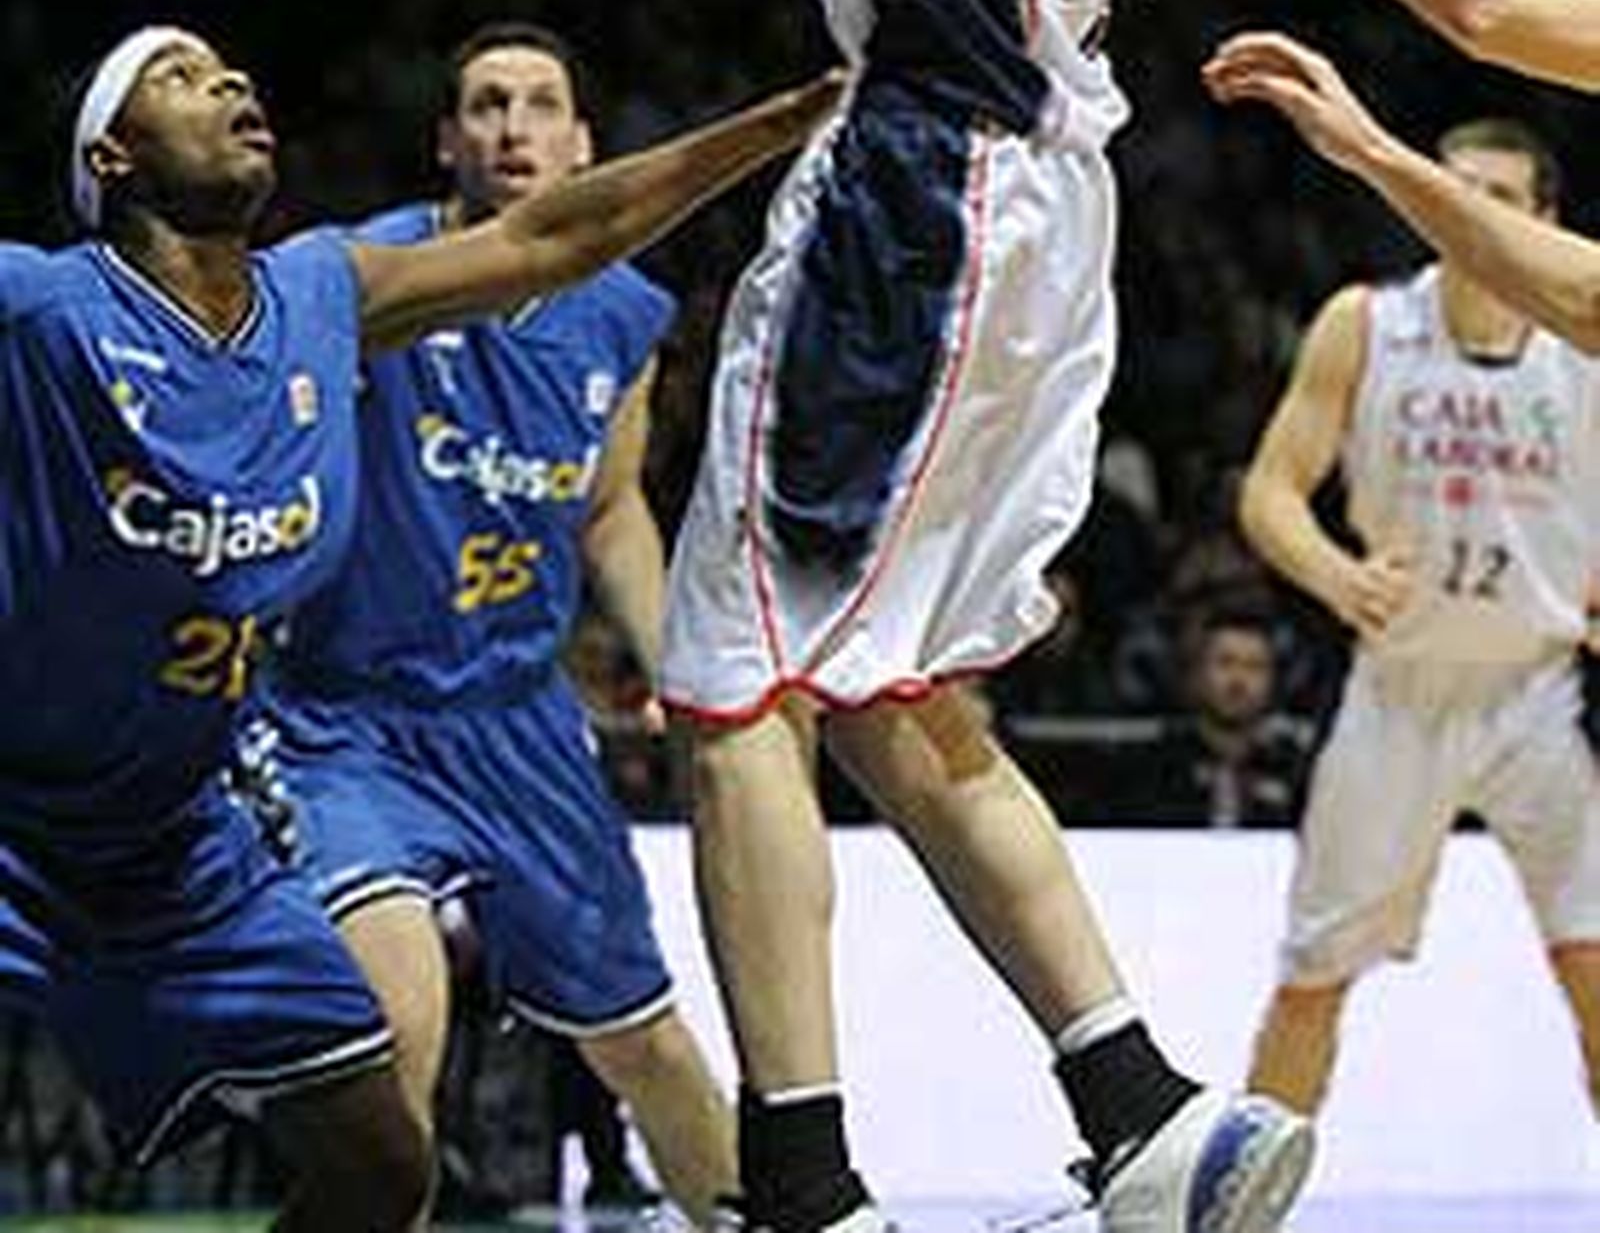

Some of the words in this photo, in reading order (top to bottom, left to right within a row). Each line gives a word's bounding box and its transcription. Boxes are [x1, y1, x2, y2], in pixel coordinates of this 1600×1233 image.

[420, 423, 602, 506] Cajasol
[109, 475, 321, 578] Cajasol
[454, 532, 540, 611] 55
